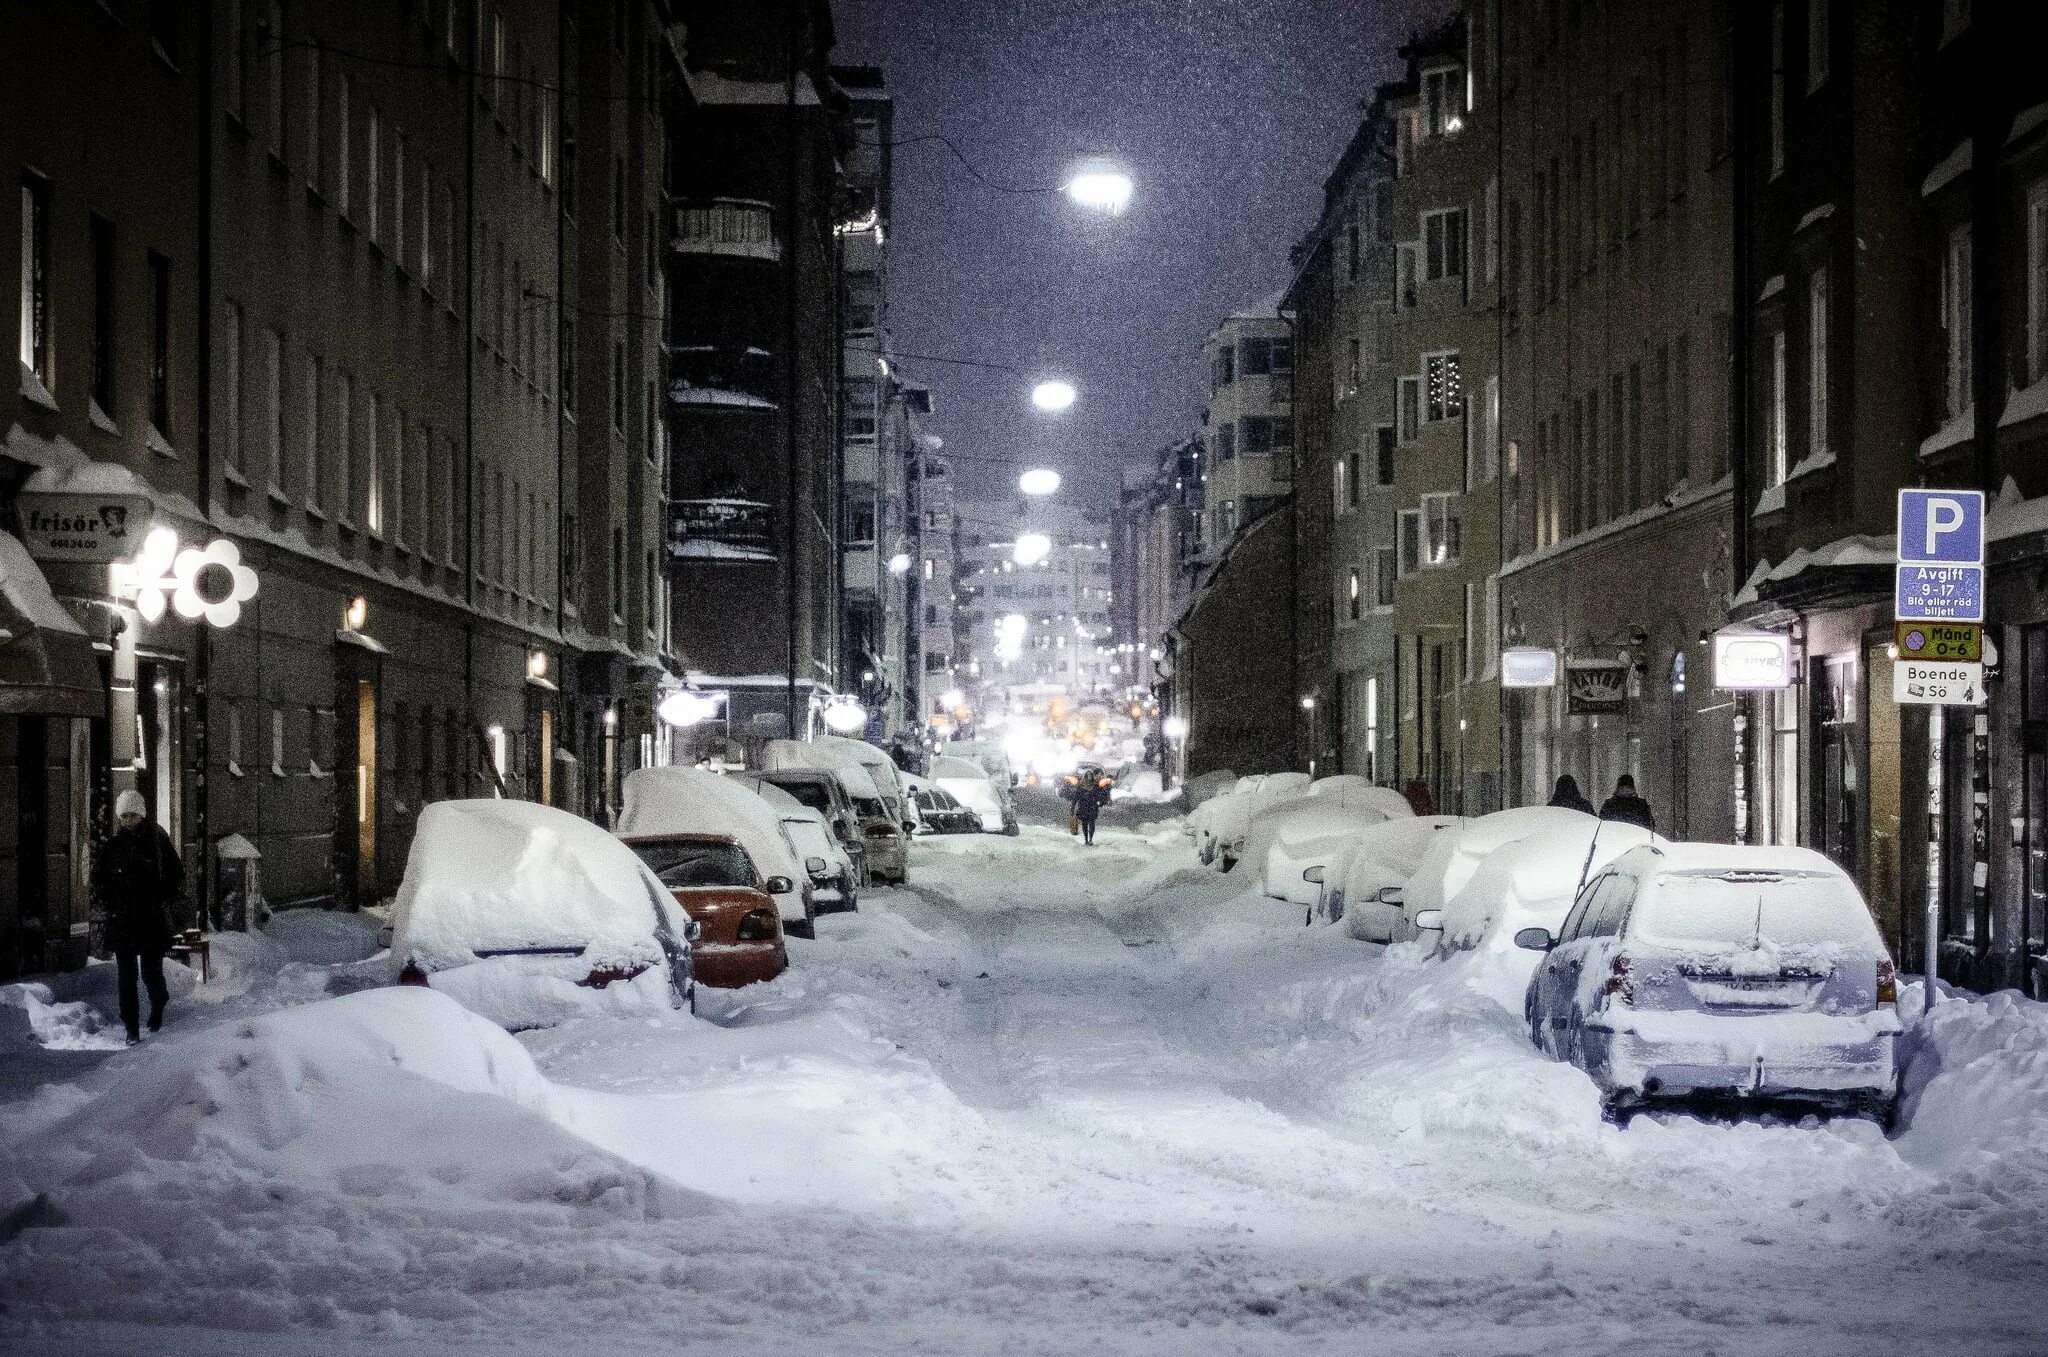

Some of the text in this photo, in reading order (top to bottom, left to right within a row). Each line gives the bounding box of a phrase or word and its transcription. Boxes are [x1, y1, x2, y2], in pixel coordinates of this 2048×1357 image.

[30, 511, 99, 532] frisör
[1926, 498, 1964, 555] P
[1917, 567, 1963, 583] Avgift
[1922, 583, 1955, 596] 9-17
[1927, 597, 1951, 606] eller
[1954, 597, 1972, 606] röd
[1924, 607, 1955, 617] biljett
[1931, 627, 1972, 641] Månd
[1936, 642, 1968, 656] 0-6
[1908, 667, 1968, 681] Boende
[1929, 685, 1947, 698] Sö
